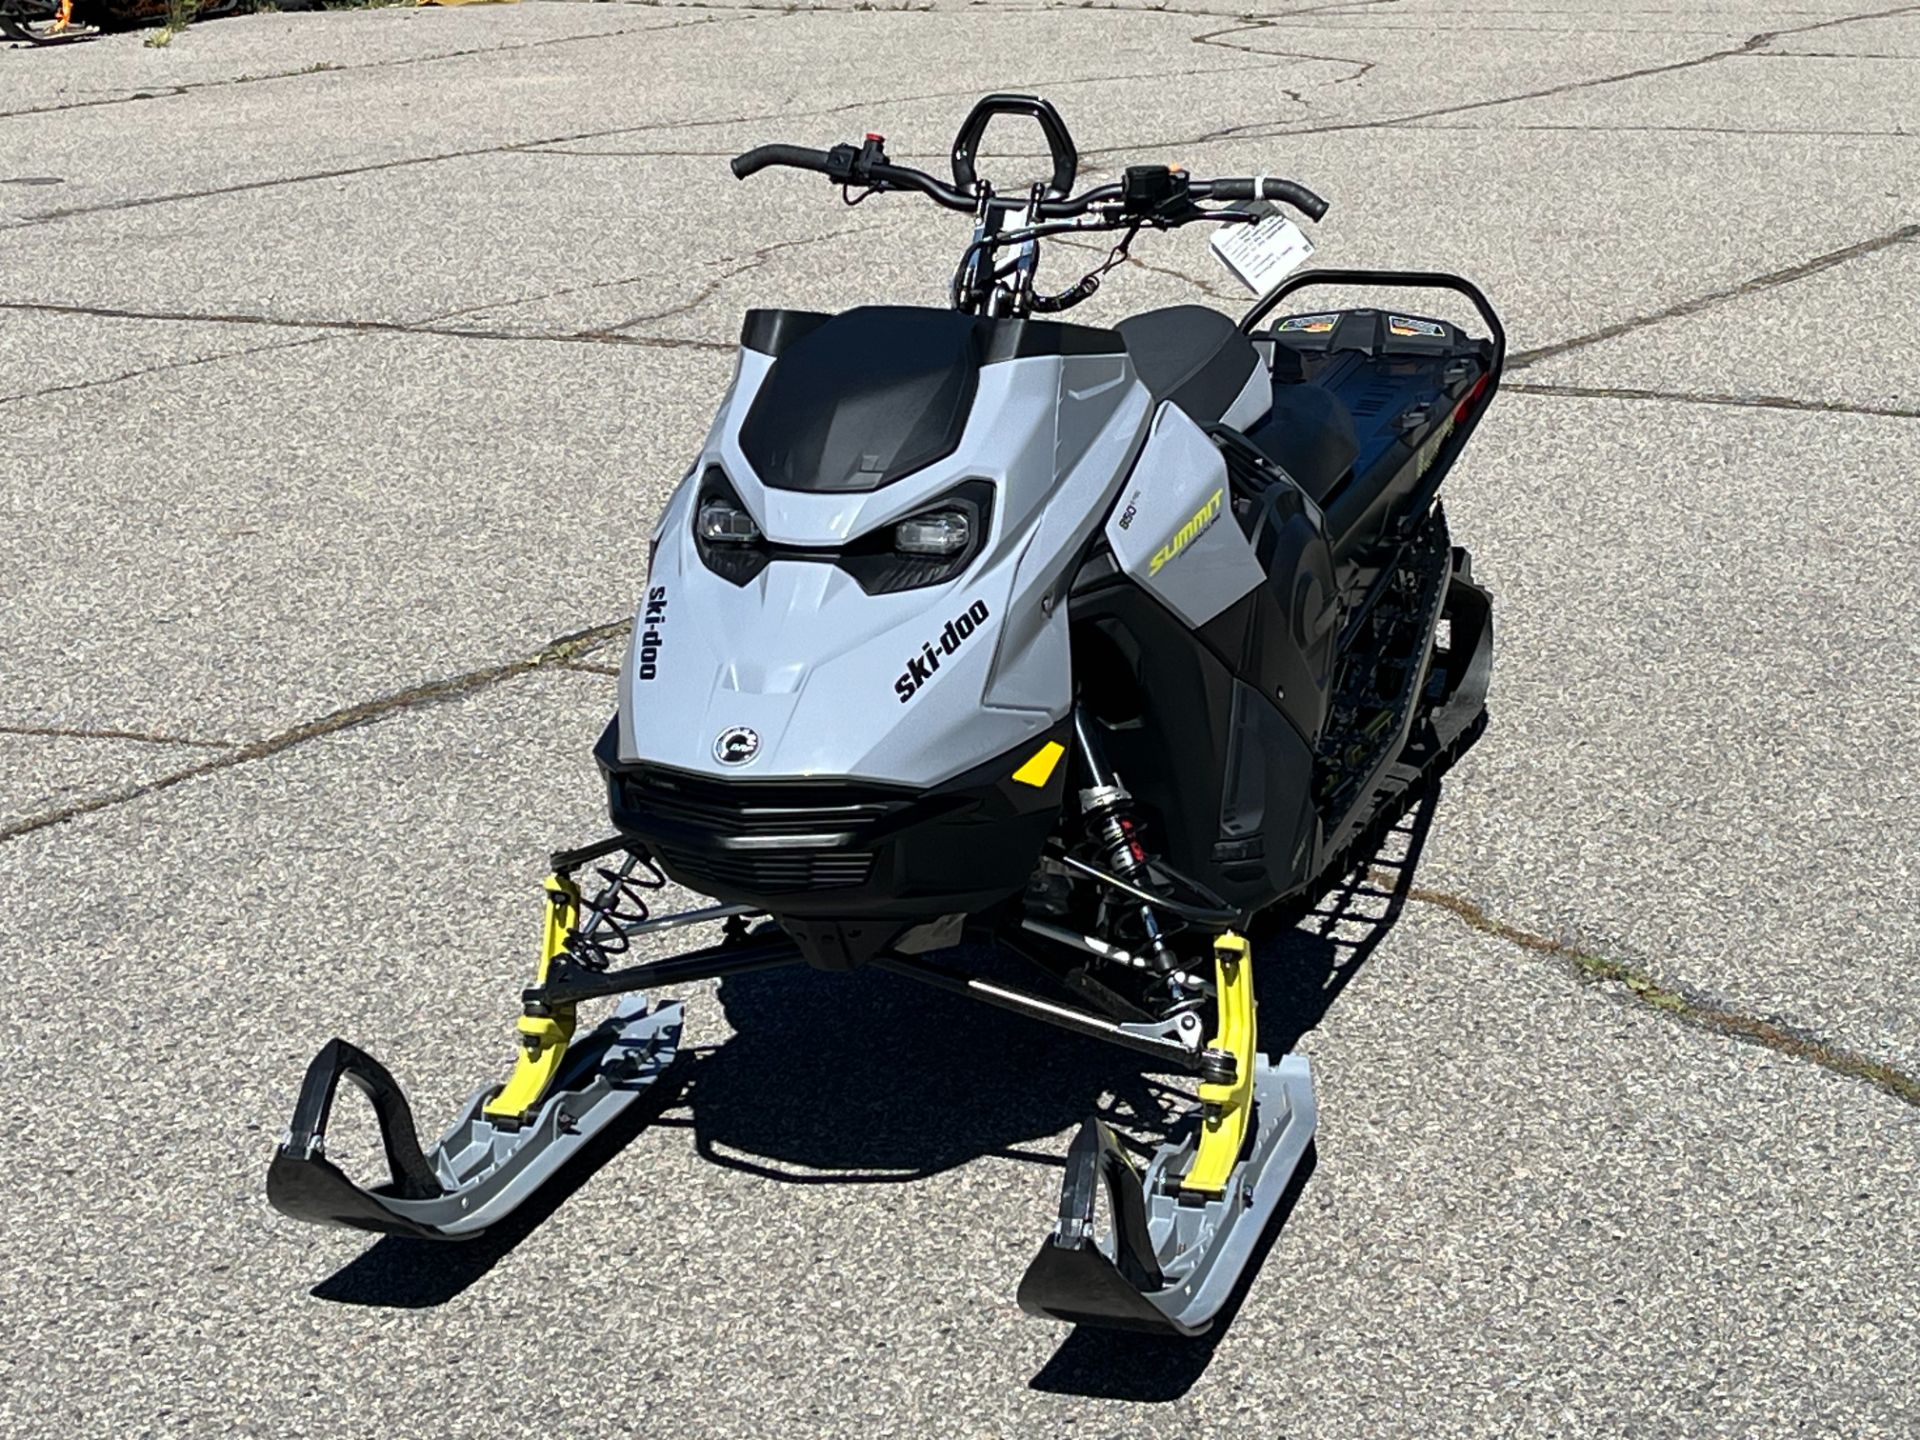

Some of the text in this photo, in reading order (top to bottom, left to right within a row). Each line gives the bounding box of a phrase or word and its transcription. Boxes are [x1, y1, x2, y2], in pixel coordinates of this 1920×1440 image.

[1119, 504, 1137, 530] 850
[1149, 488, 1224, 577] SUMMIT
[639, 586, 668, 680] ski-doo
[894, 599, 990, 703] ski-doo
